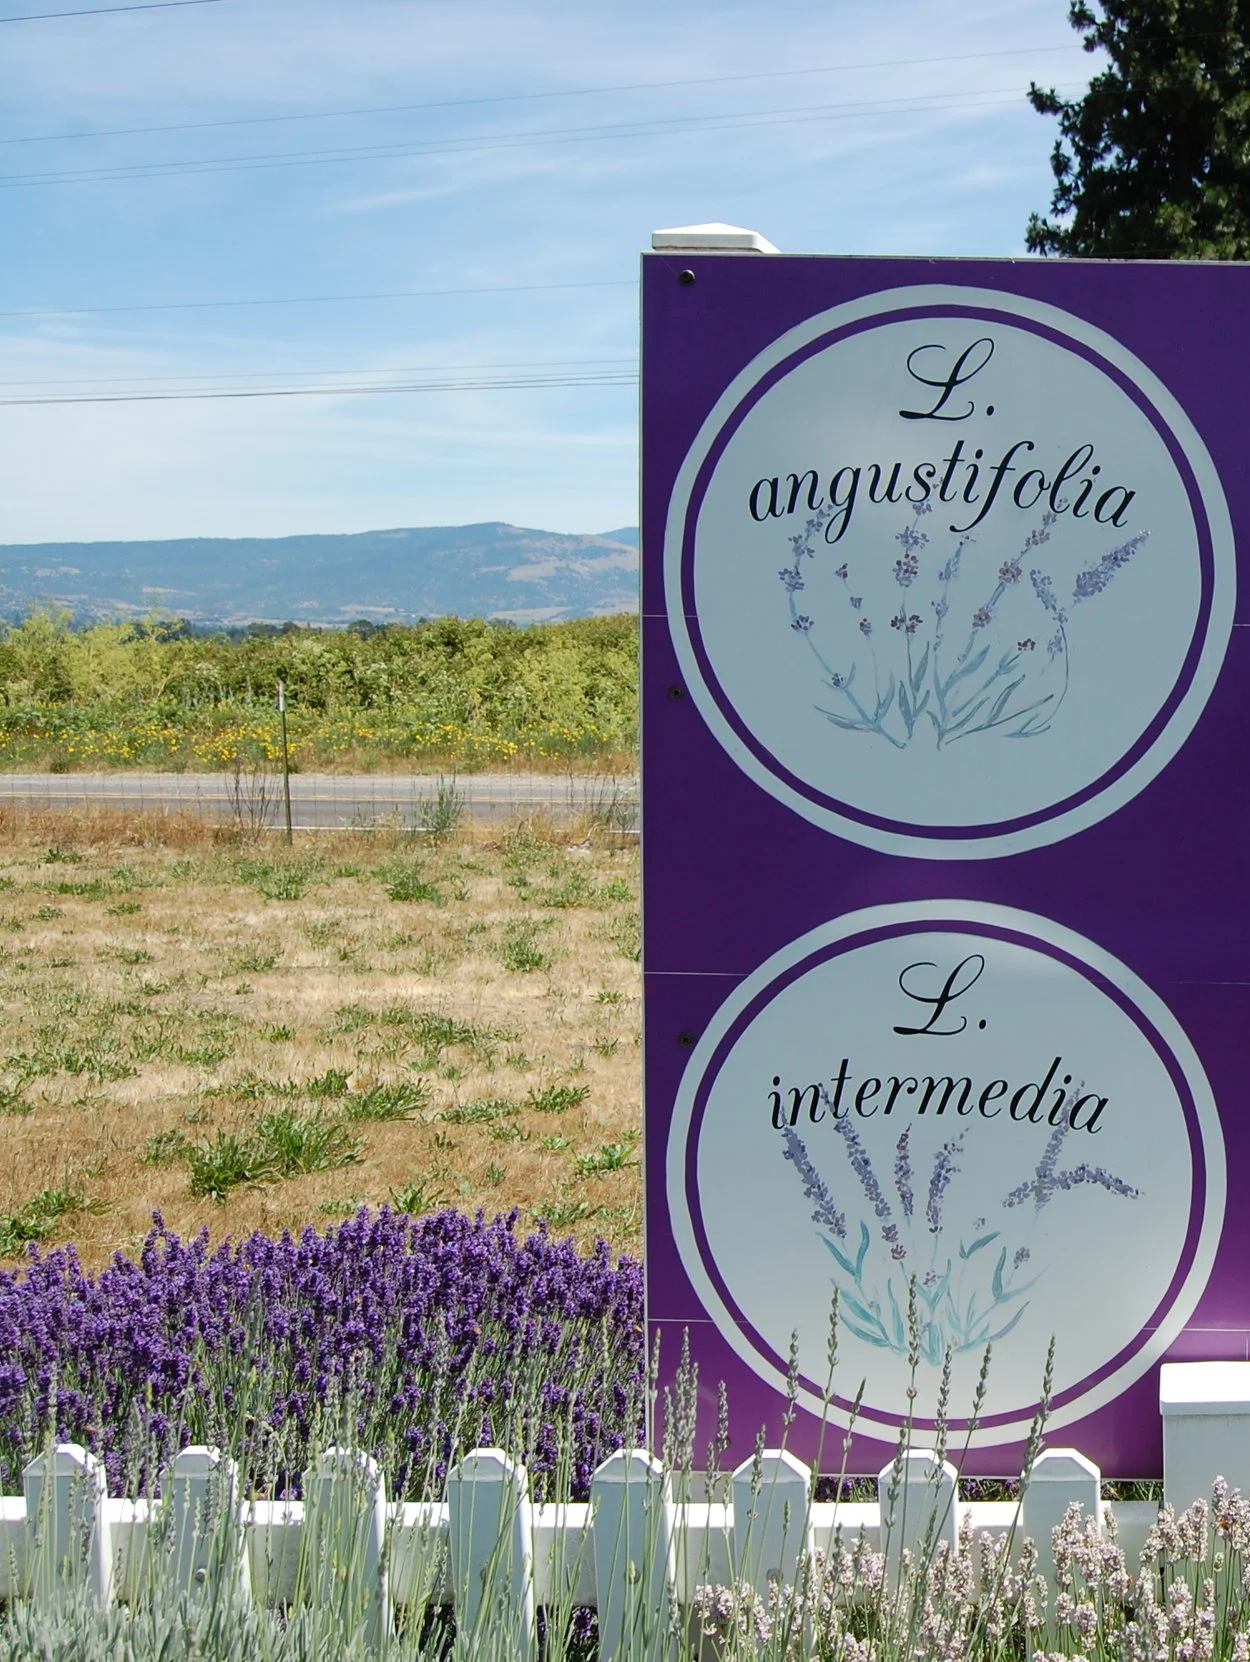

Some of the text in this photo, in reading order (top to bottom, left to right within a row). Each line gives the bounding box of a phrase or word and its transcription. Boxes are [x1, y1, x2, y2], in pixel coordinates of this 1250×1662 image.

[899, 337, 995, 421] L.
[749, 440, 1136, 544] angustifolia
[892, 954, 987, 1036] L.
[767, 1056, 1110, 1134] intermedia
